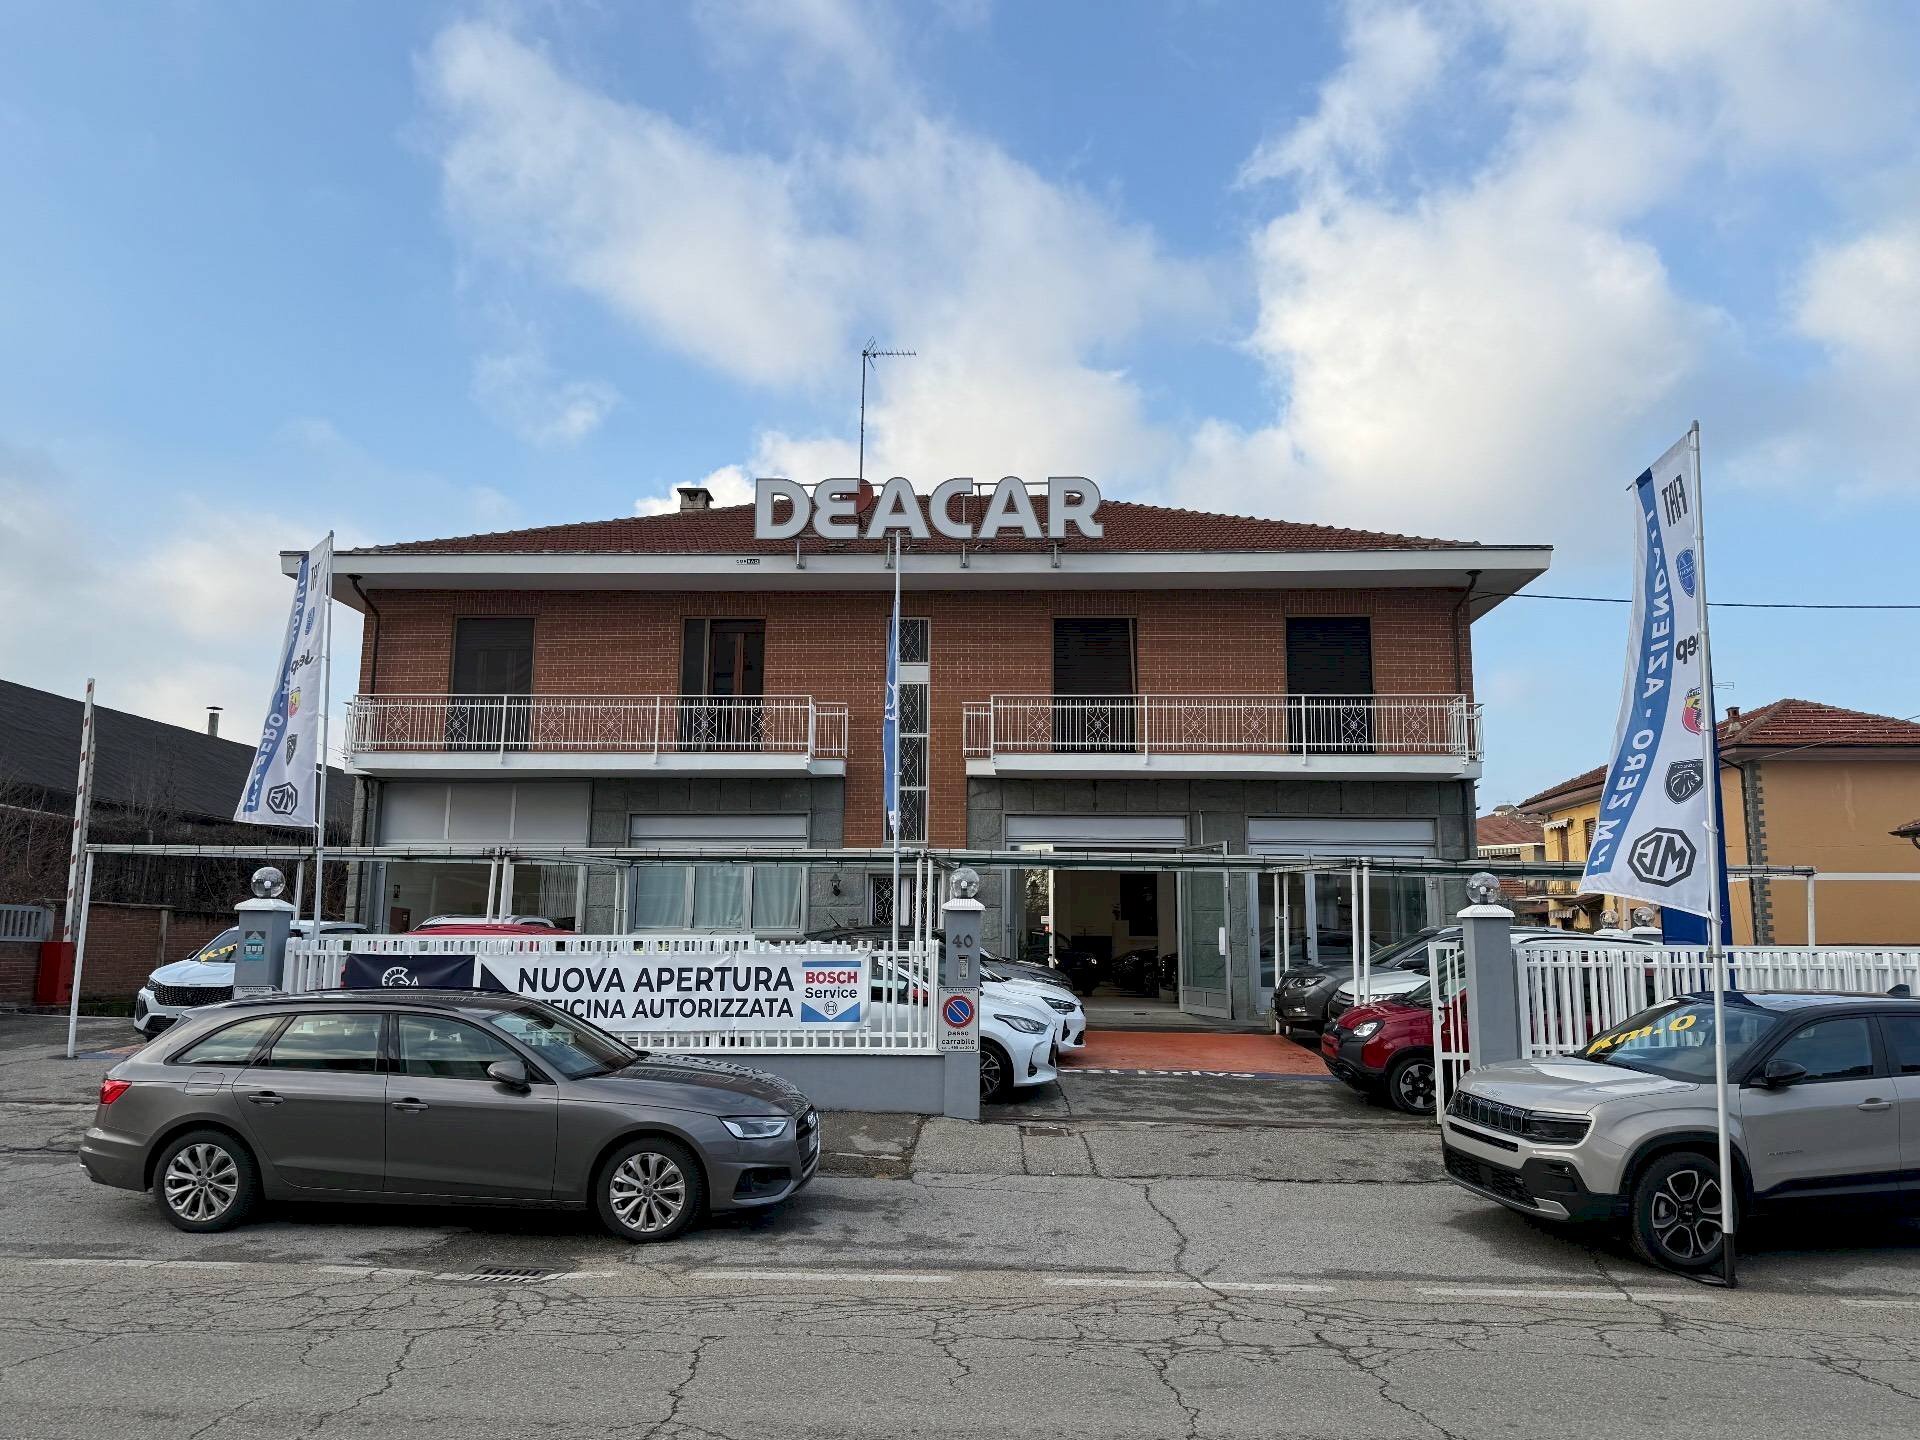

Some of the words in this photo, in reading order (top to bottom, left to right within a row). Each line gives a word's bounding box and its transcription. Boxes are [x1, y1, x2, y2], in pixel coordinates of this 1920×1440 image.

[754, 476, 1104, 540] DEACAR
[952, 934, 973, 948] 40
[518, 967, 626, 993] NUOVA
[632, 966, 795, 993] APERTURA
[805, 971, 858, 984] BOSCH
[804, 986, 858, 999] Service
[542, 998, 626, 1019] ICINA
[631, 998, 794, 1019] AUTORIZZATA
